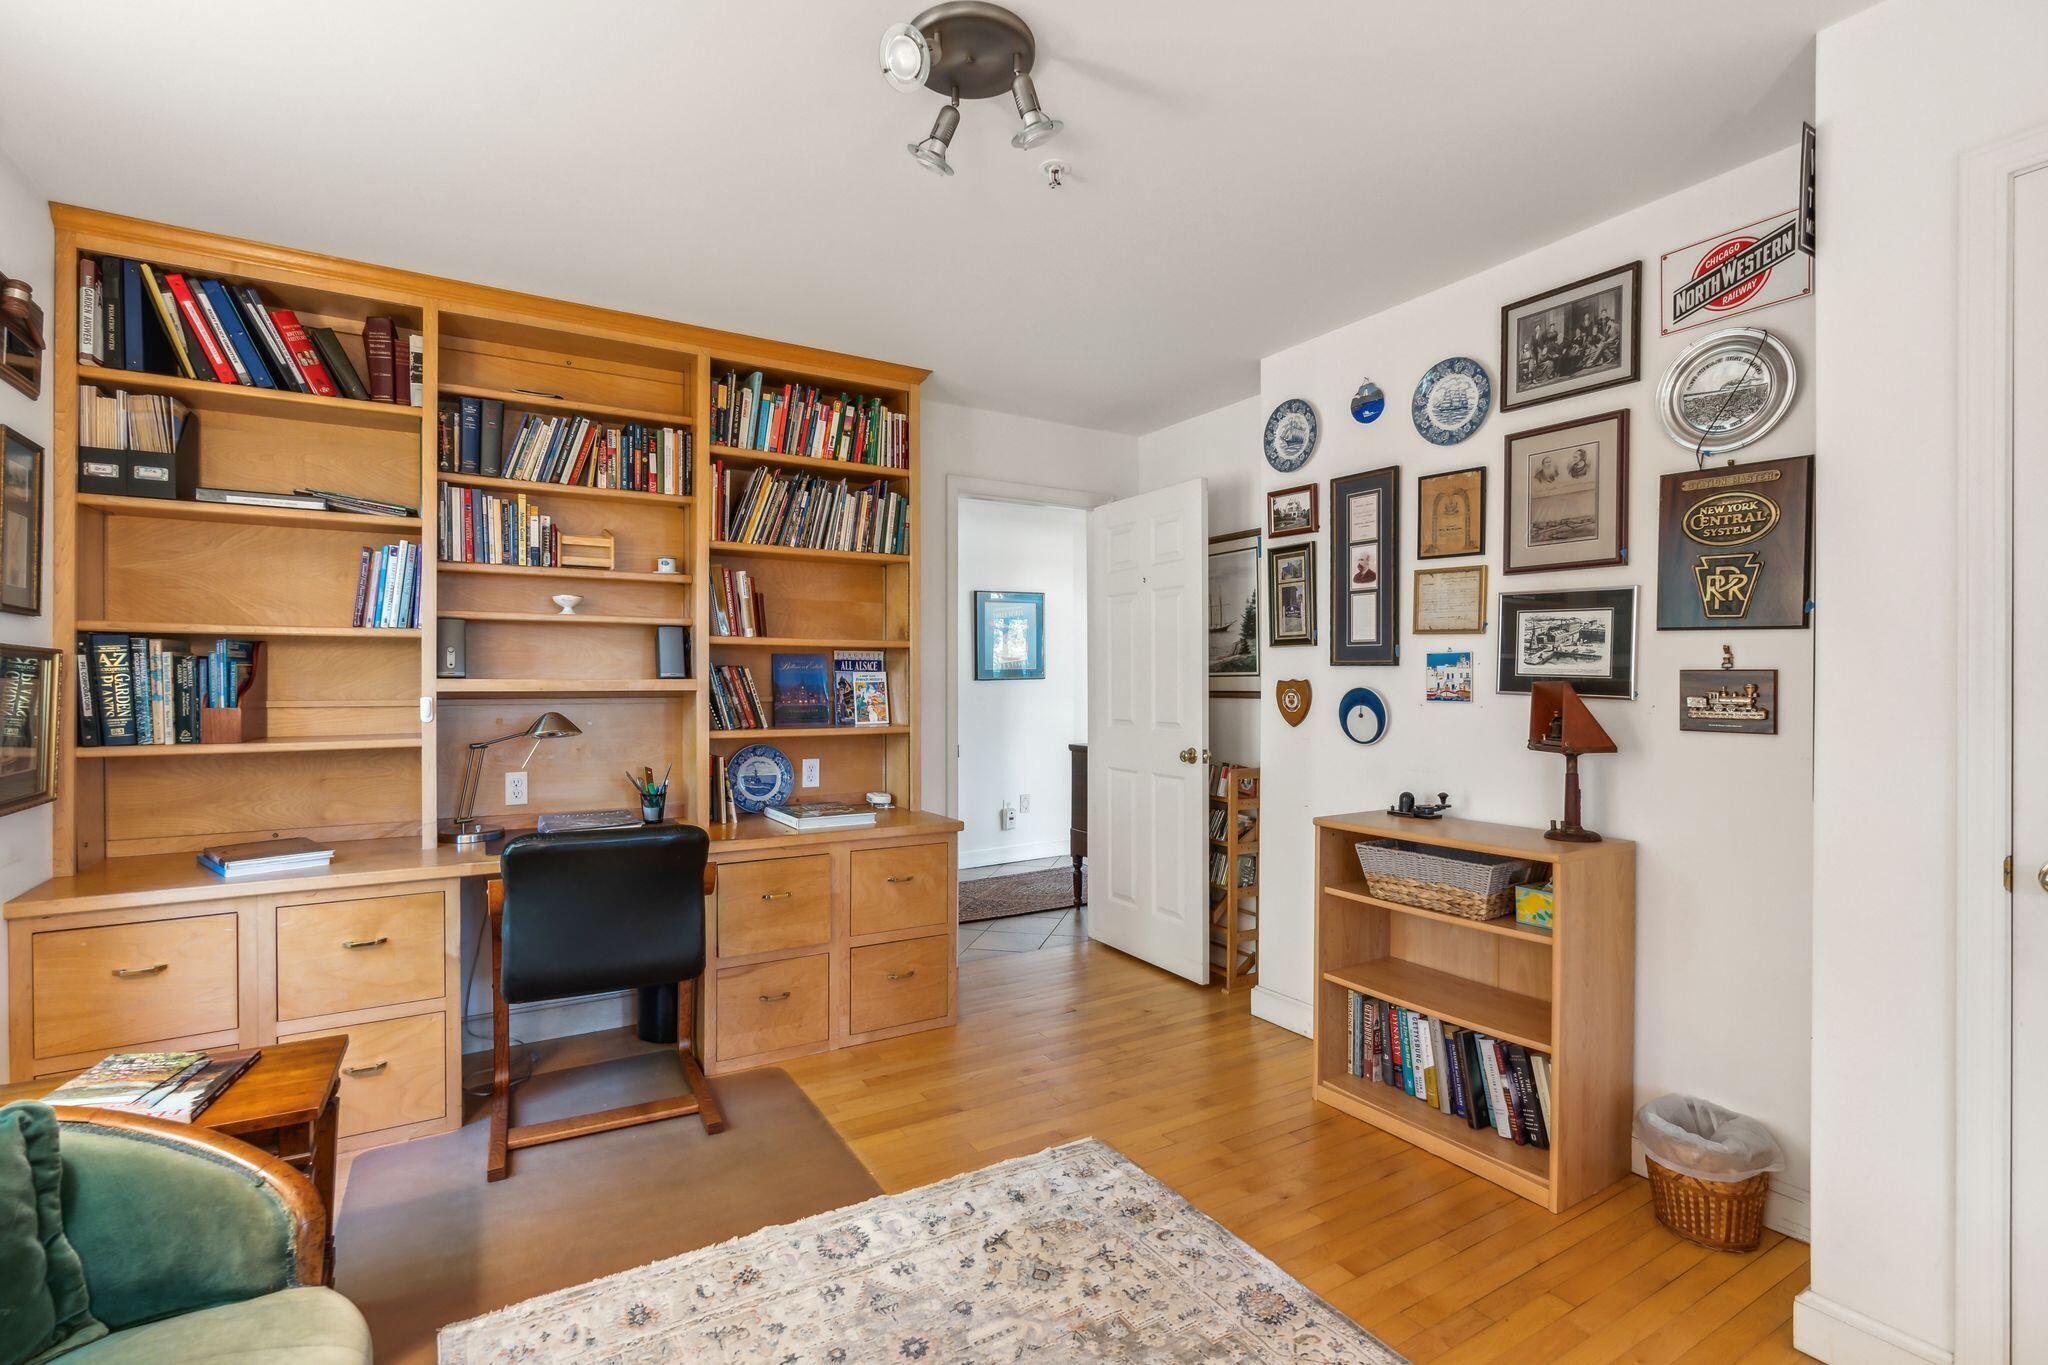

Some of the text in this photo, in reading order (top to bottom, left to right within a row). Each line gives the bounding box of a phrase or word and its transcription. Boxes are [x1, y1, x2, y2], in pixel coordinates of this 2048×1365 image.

[1705, 243, 1740, 268] CHICAGO
[1722, 279, 1758, 305] RAILWAY
[83, 288, 93, 345] GARDEN ANSWERS
[1690, 511, 1766, 530] CENTRAL
[1700, 501, 1759, 515] NEW YORK
[1703, 525, 1751, 536] SYSTEM
[841, 661, 878, 671] ALL ALSACE
[81, 672, 90, 710] CORPORATORS
[100, 675, 115, 718] PLANTS
[115, 674, 131, 716] GARDEN
[1391, 1014, 1400, 1056] DYNASTY
[1412, 1017, 1421, 1063] GETTYSBURG
